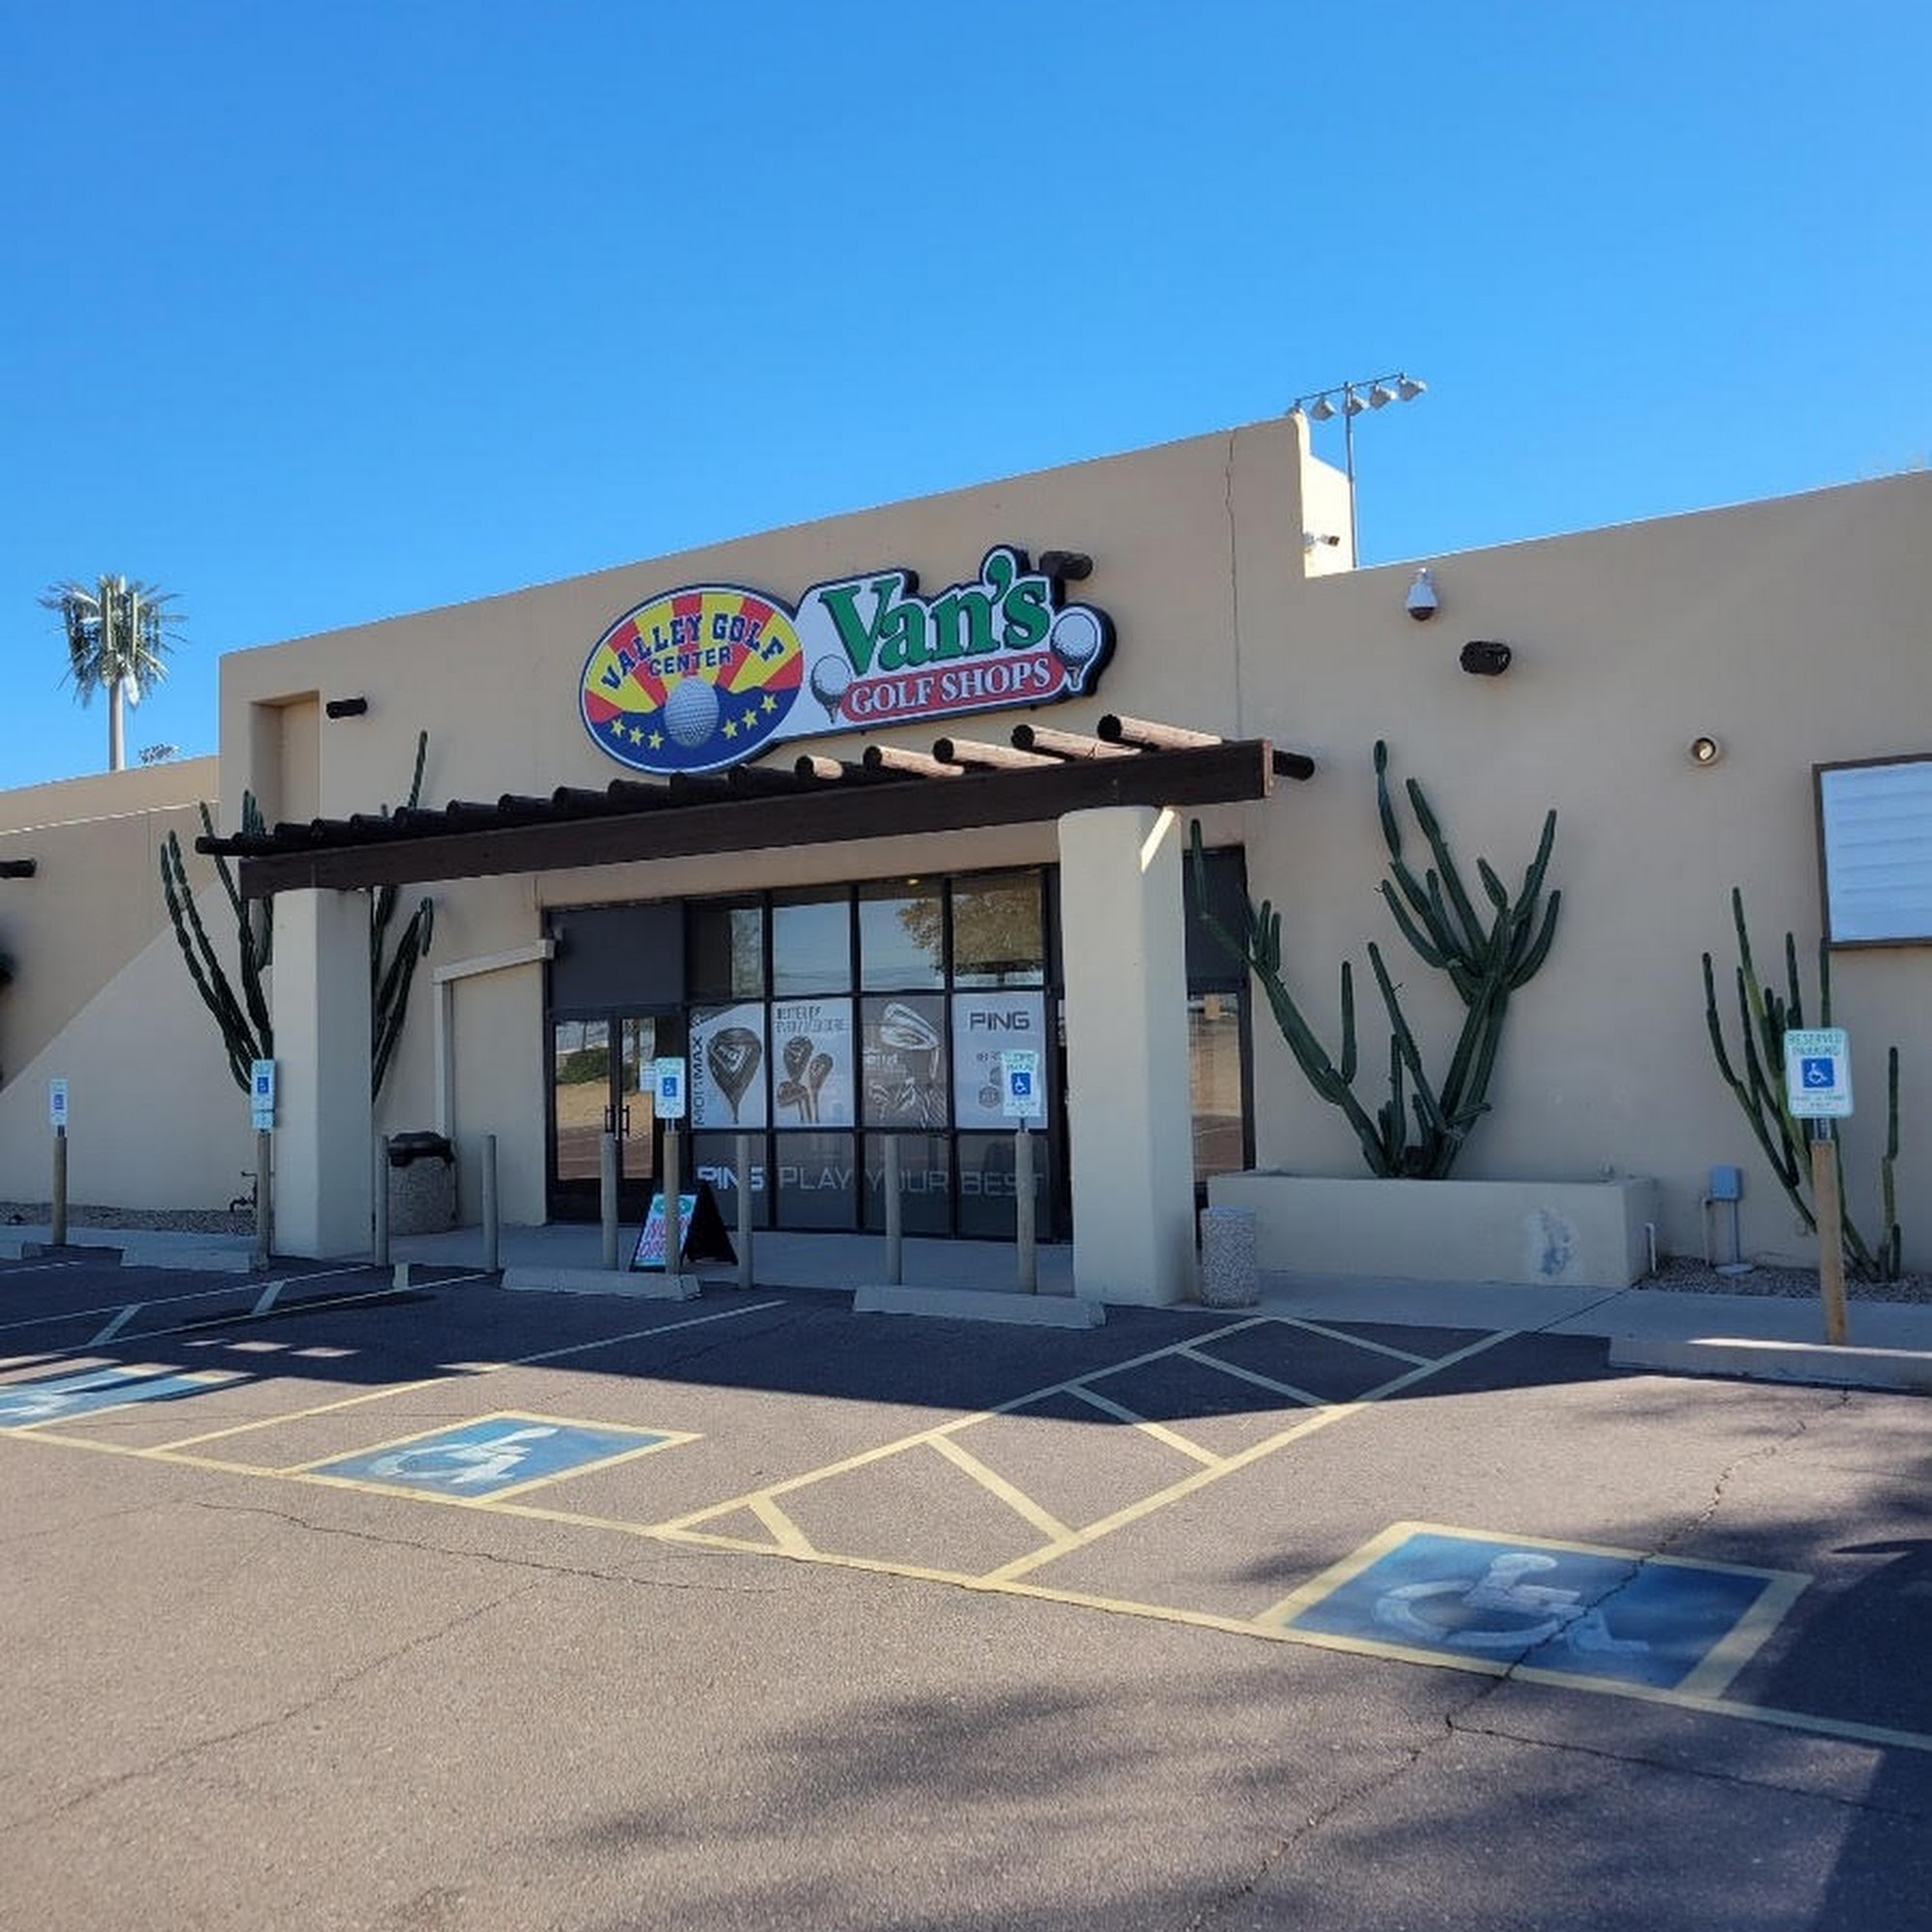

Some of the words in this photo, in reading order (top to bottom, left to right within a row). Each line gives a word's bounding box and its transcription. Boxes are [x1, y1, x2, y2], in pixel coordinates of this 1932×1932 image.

[819, 554, 1051, 677] Van's
[601, 611, 703, 690] VALLEY
[712, 612, 784, 662] GOLF
[648, 645, 732, 677] CENTER
[851, 677, 935, 715] GOLF
[941, 657, 1052, 702] SHOPS
[970, 1011, 1031, 1031] PING
[779, 1166, 852, 1190] PLAY
[865, 1169, 949, 1193] YUR
